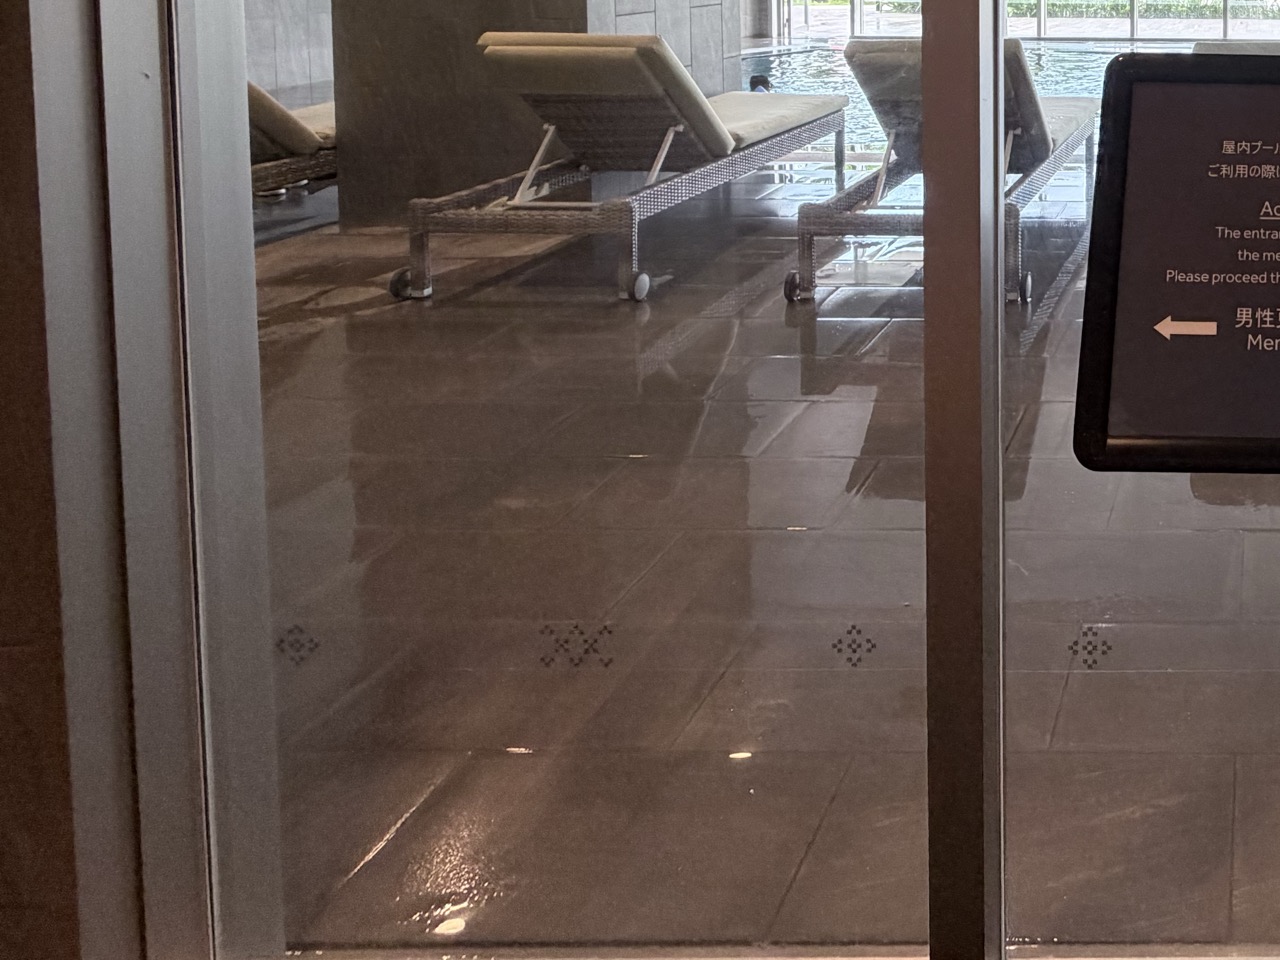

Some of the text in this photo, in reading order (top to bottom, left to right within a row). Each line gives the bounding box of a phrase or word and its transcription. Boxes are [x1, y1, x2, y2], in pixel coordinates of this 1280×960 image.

[1214, 225, 1242, 240] The
[1237, 248, 1261, 262] the
[1165, 269, 1210, 283] Please
[1211, 270, 1268, 286] proceed
